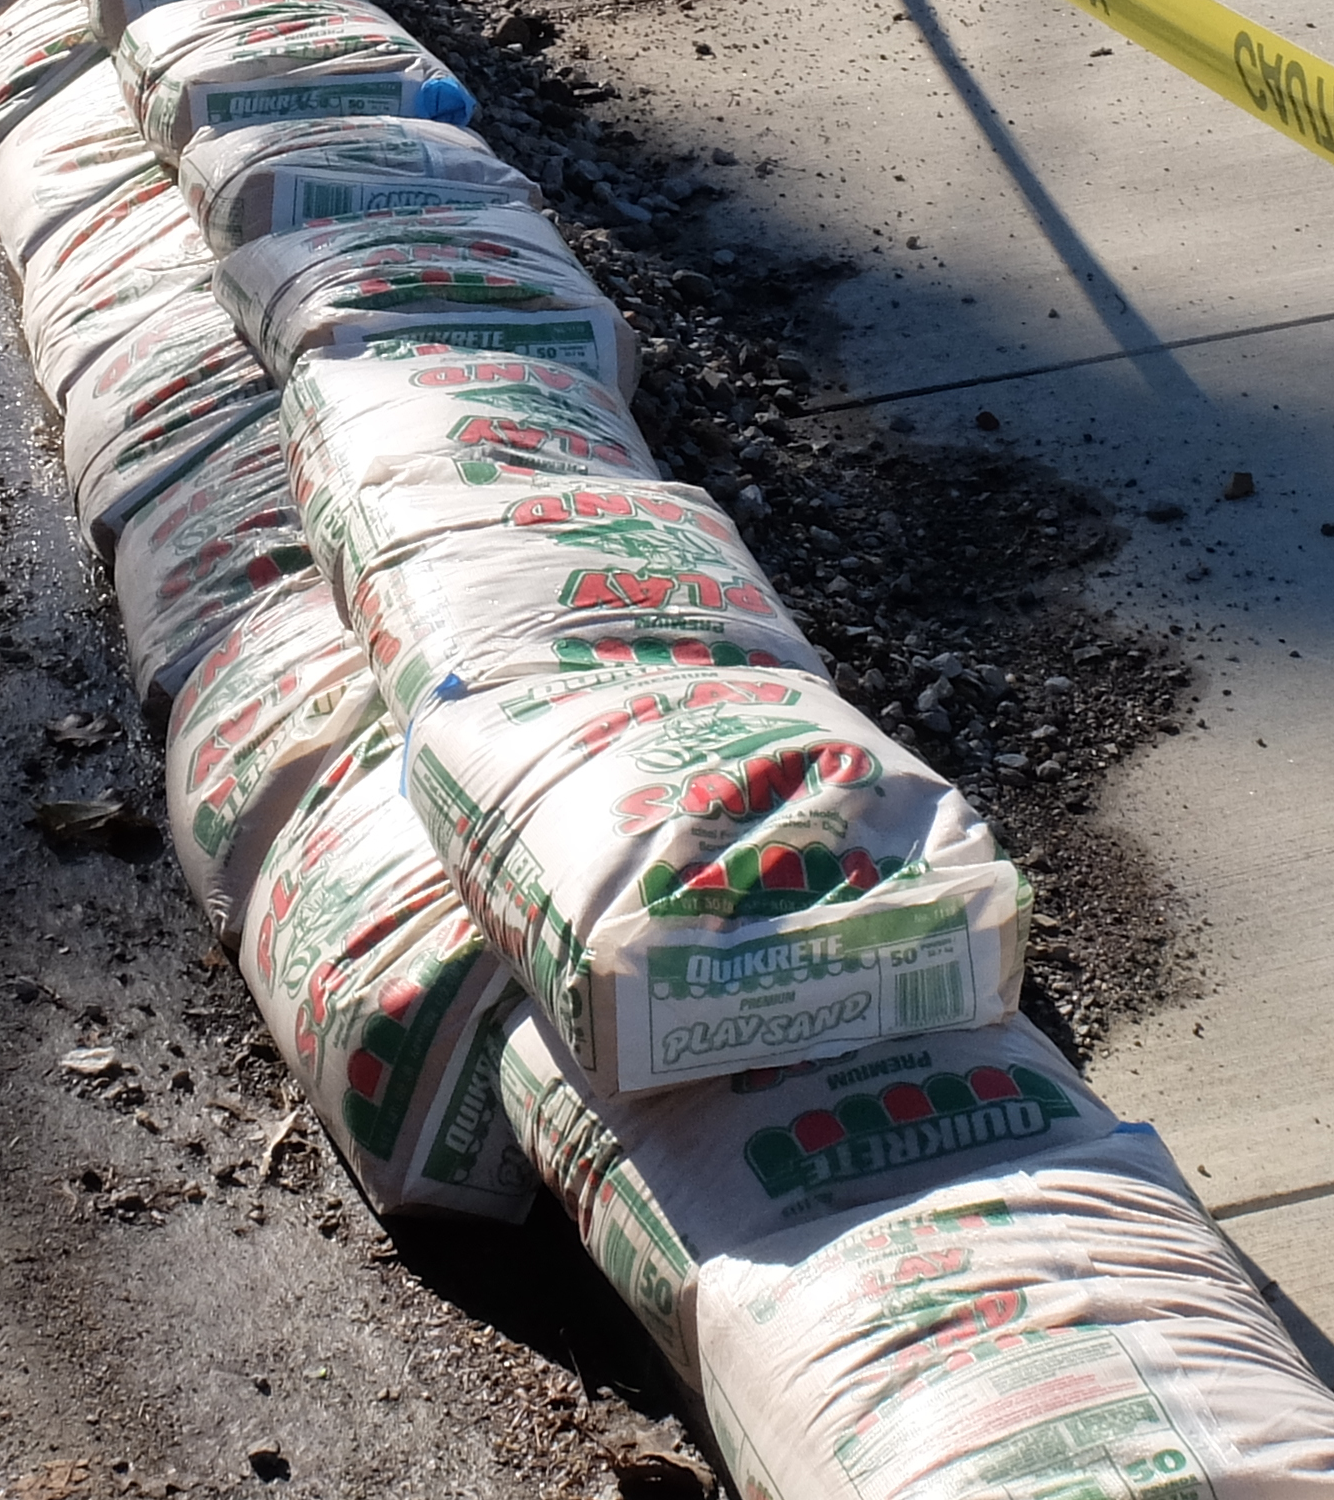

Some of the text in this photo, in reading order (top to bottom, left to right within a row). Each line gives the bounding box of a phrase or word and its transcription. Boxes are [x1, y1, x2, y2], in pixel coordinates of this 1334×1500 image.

[536, 347, 557, 359] 50
[558, 567, 777, 618] PLAY
[634, 615, 725, 634] PREMIUM
[623, 671, 719, 690] PREMIUM
[570, 679, 801, 760] PLAY
[611, 739, 884, 837] SAND
[686, 934, 917, 985] QUIKRETE 50
[739, 991, 796, 1011] PREMIUM
[664, 991, 872, 1065] PLAY SAND
[827, 1051, 933, 1091] PREMIUM
[800, 1101, 1047, 1182] QUIKRETE
[1124, 1448, 1187, 1482] 50
